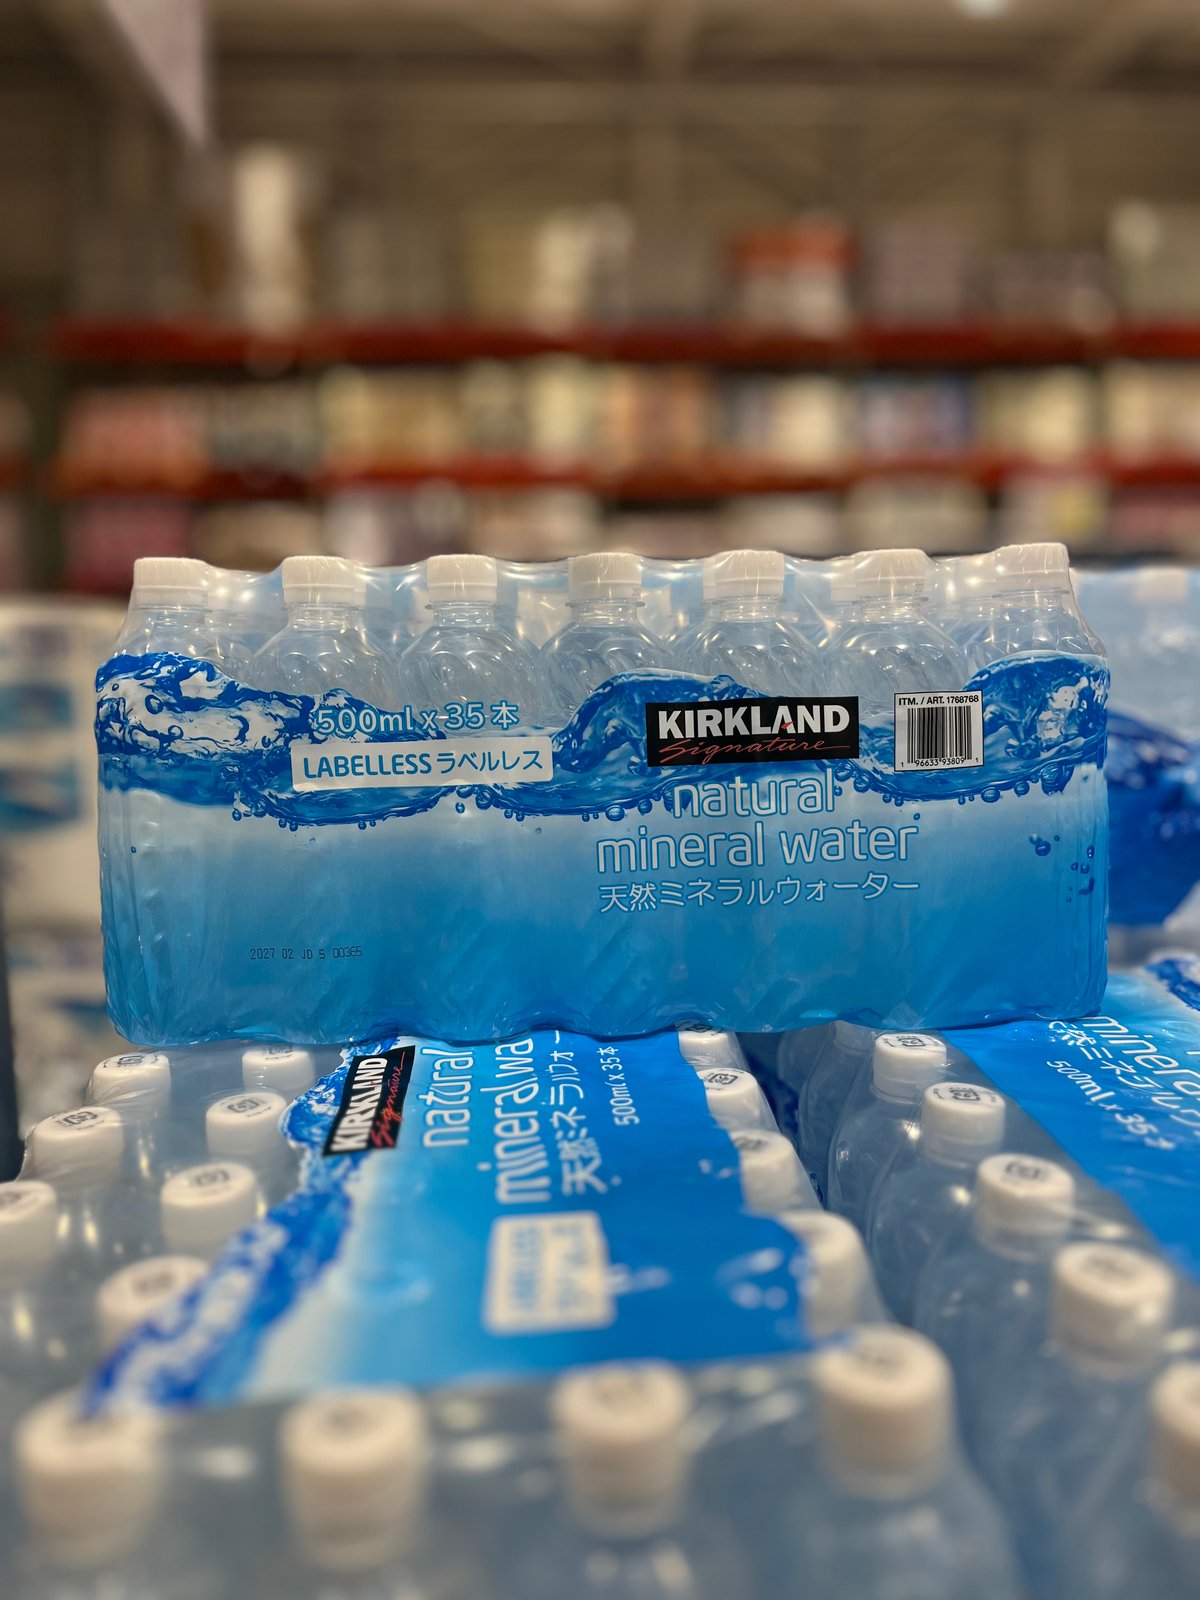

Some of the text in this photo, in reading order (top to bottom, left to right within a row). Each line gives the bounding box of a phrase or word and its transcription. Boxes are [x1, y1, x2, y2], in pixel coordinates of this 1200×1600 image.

[316, 705, 414, 735] 500ml
[898, 697, 919, 706] ITM.
[926, 695, 945, 705] ART.
[946, 694, 979, 704] 1768768
[657, 704, 851, 740] KIRKLAND
[303, 750, 543, 779] LABELLESS ラベルレス
[659, 736, 850, 765] Signature
[672, 767, 836, 819] natural
[596, 819, 919, 874] mineral water
[599, 872, 920, 913] 天然ミネラルウォーター
[250, 947, 275, 960] 2027
[281, 948, 295, 960] 02
[1075, 1015, 1200, 1102] minera
[329, 1057, 388, 1152] KIRKLAND
[418, 1047, 474, 1148] natural
[477, 1076, 552, 1204] mineral
